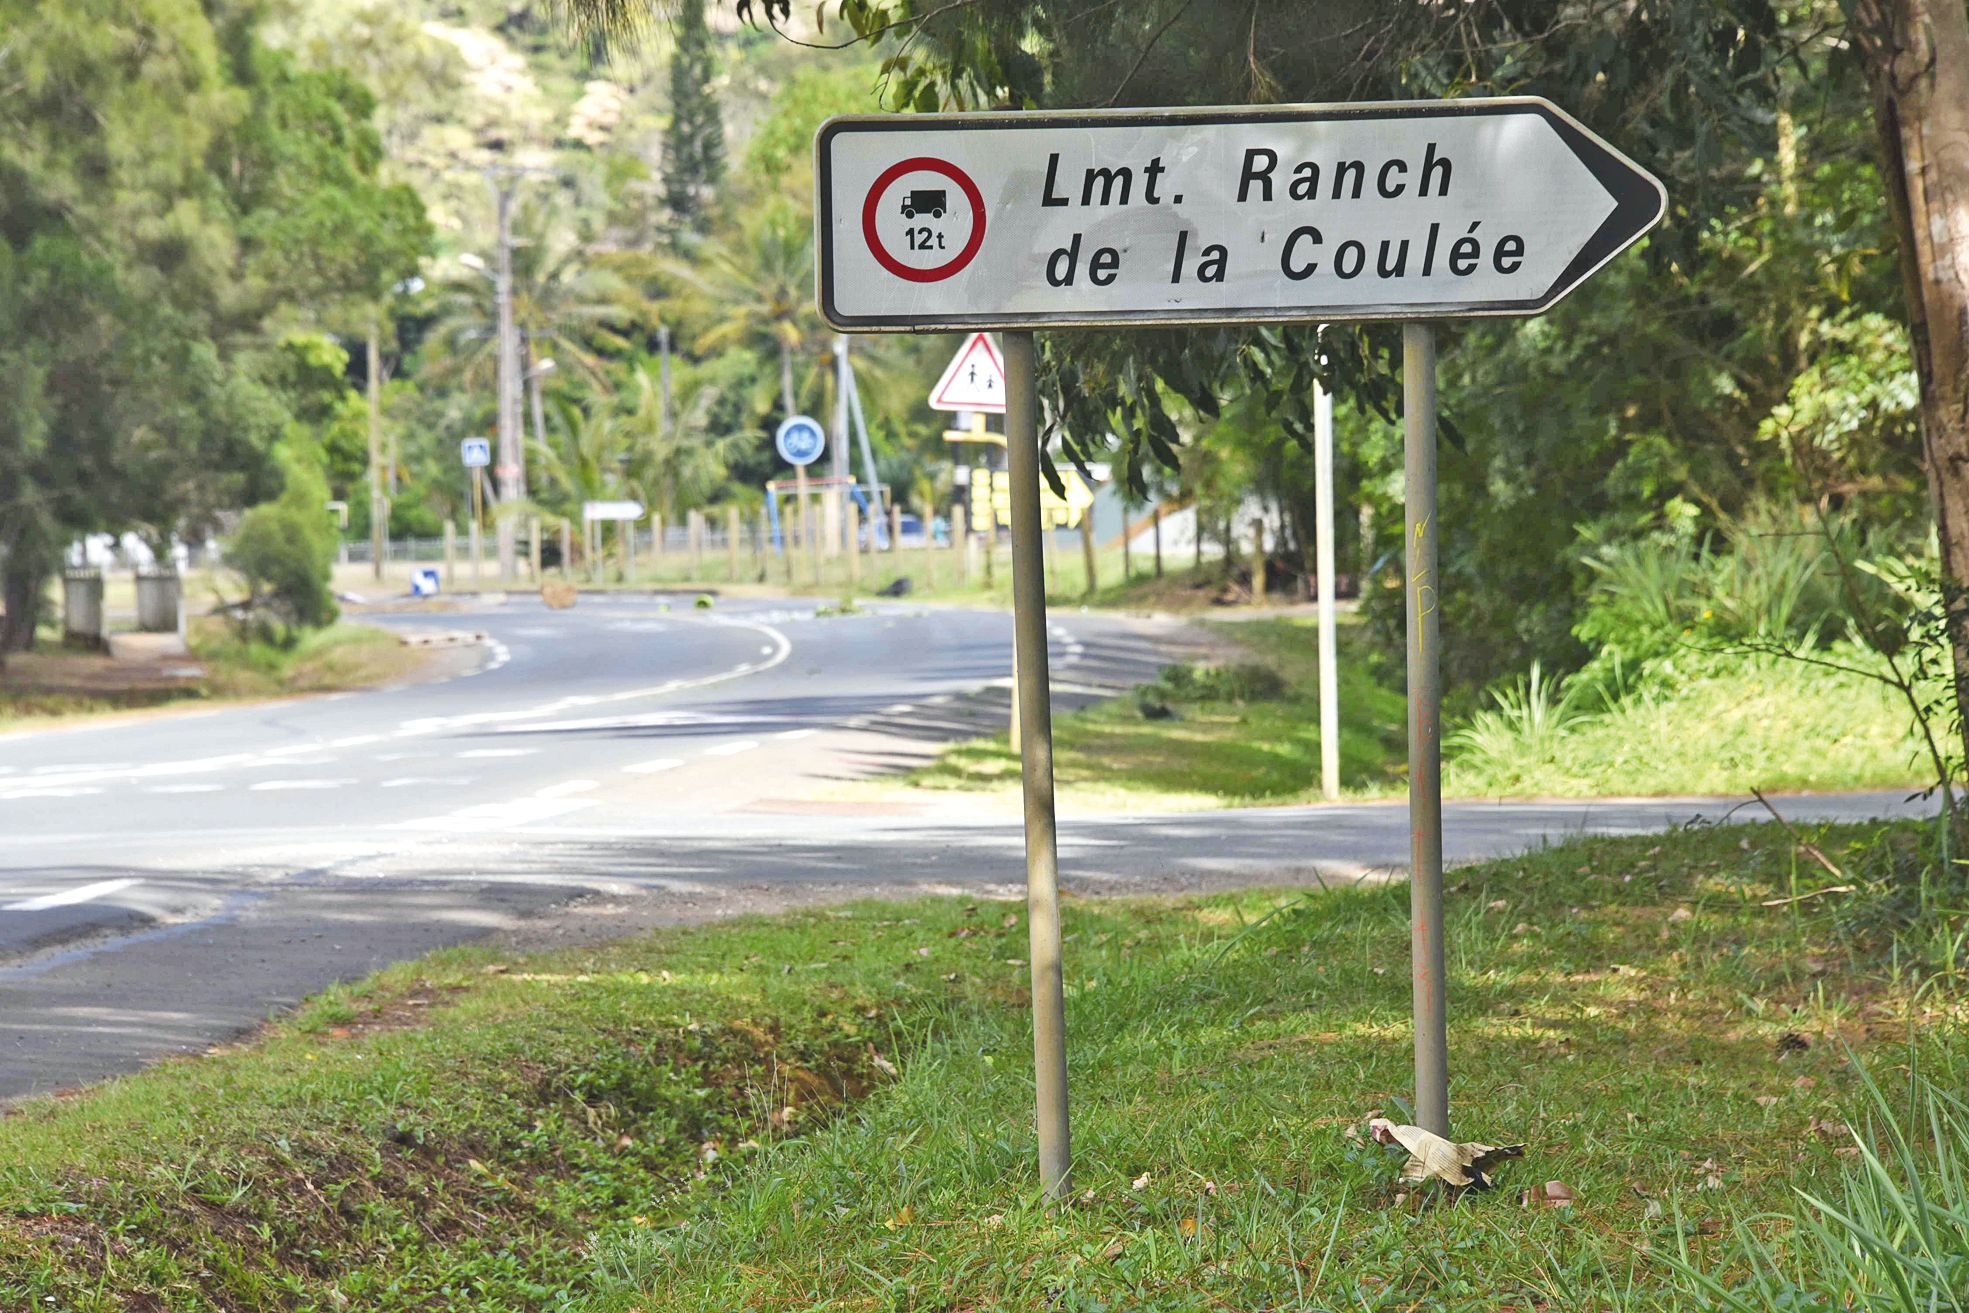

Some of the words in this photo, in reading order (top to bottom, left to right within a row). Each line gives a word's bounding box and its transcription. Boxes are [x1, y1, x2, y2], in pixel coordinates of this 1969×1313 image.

[1042, 153, 1185, 207] Lmt.
[1237, 143, 1453, 203] Ranch
[1046, 233, 1120, 288] de
[1171, 231, 1228, 284] la
[1281, 221, 1525, 281] Coulée
